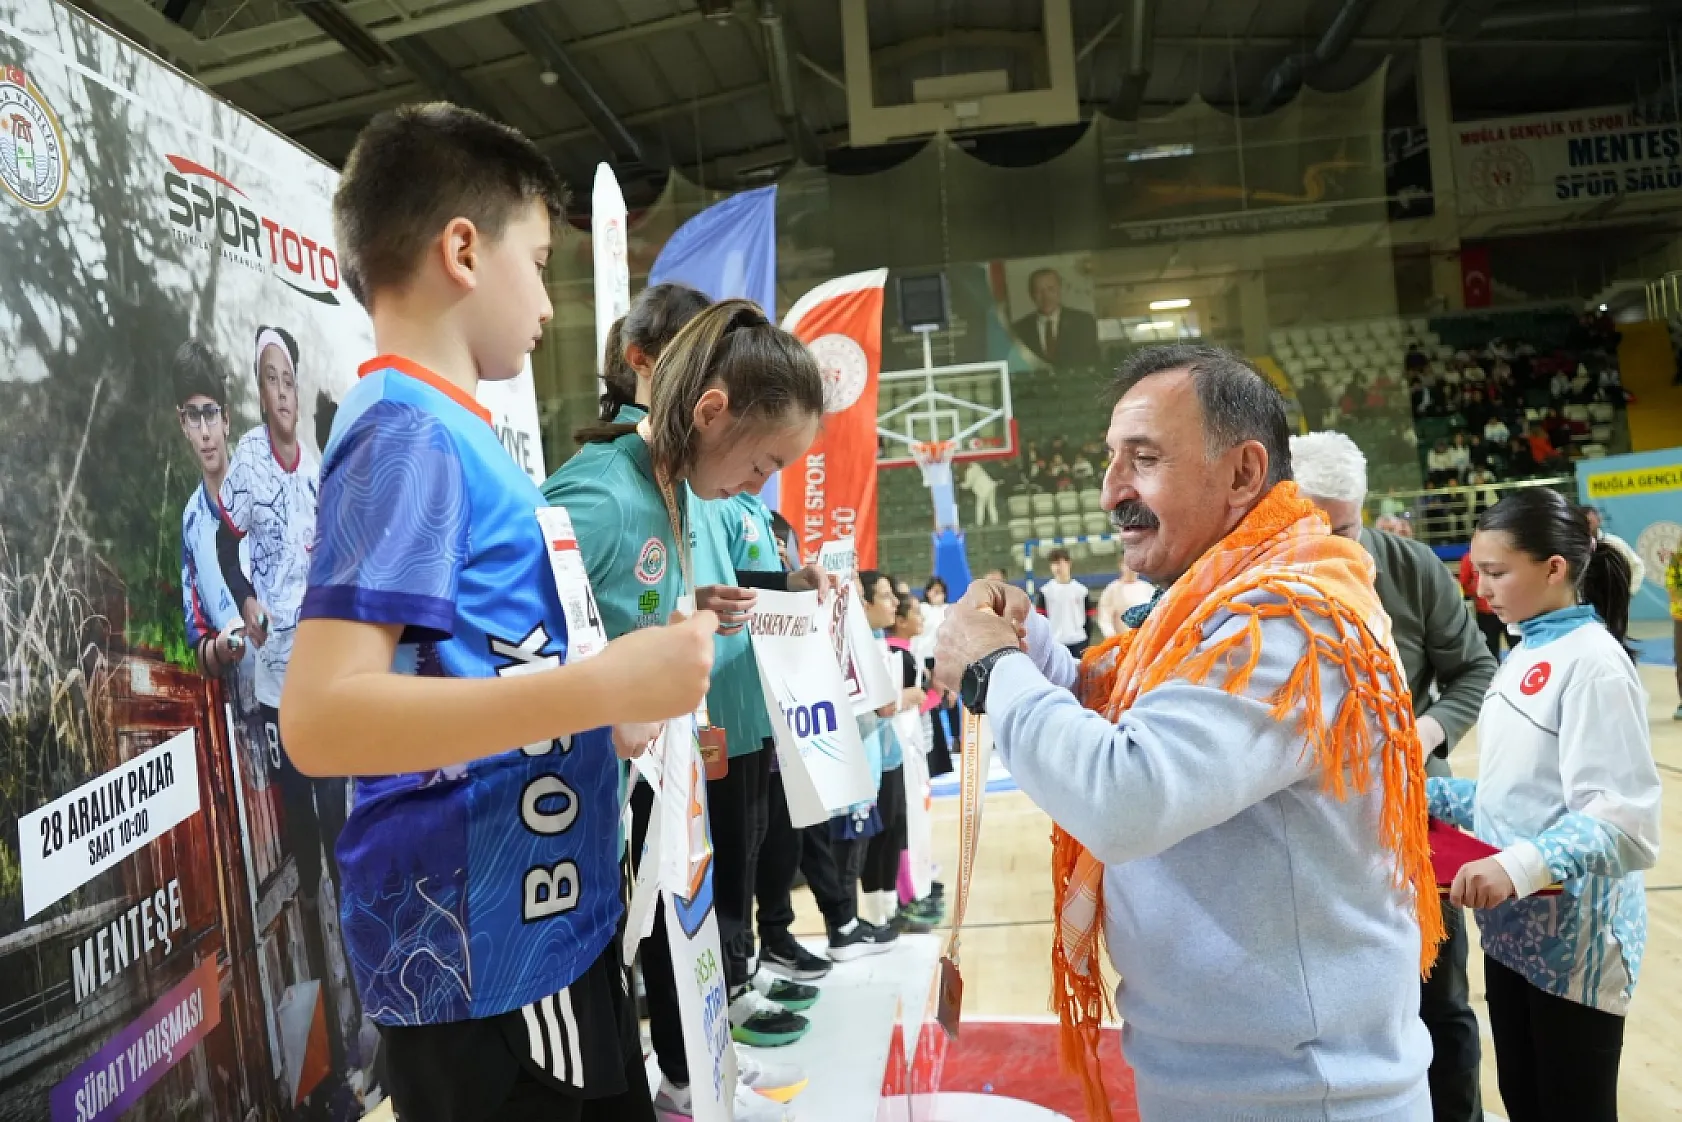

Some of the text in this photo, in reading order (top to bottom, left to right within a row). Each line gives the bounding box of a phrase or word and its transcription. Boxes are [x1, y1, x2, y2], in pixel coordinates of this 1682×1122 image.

[1555, 170, 1619, 200] SPOR
[1568, 127, 1682, 168] MENTEŞ
[804, 452, 826, 510] SPOR
[40, 751, 174, 859] 28 ARALIK PAZAR
[488, 619, 581, 924] BOK
[88, 809, 149, 866] SAAT 10:00
[71, 878, 184, 1003] MENTEŞE
[74, 987, 204, 1122] SÜRAT YARIŞMASI
